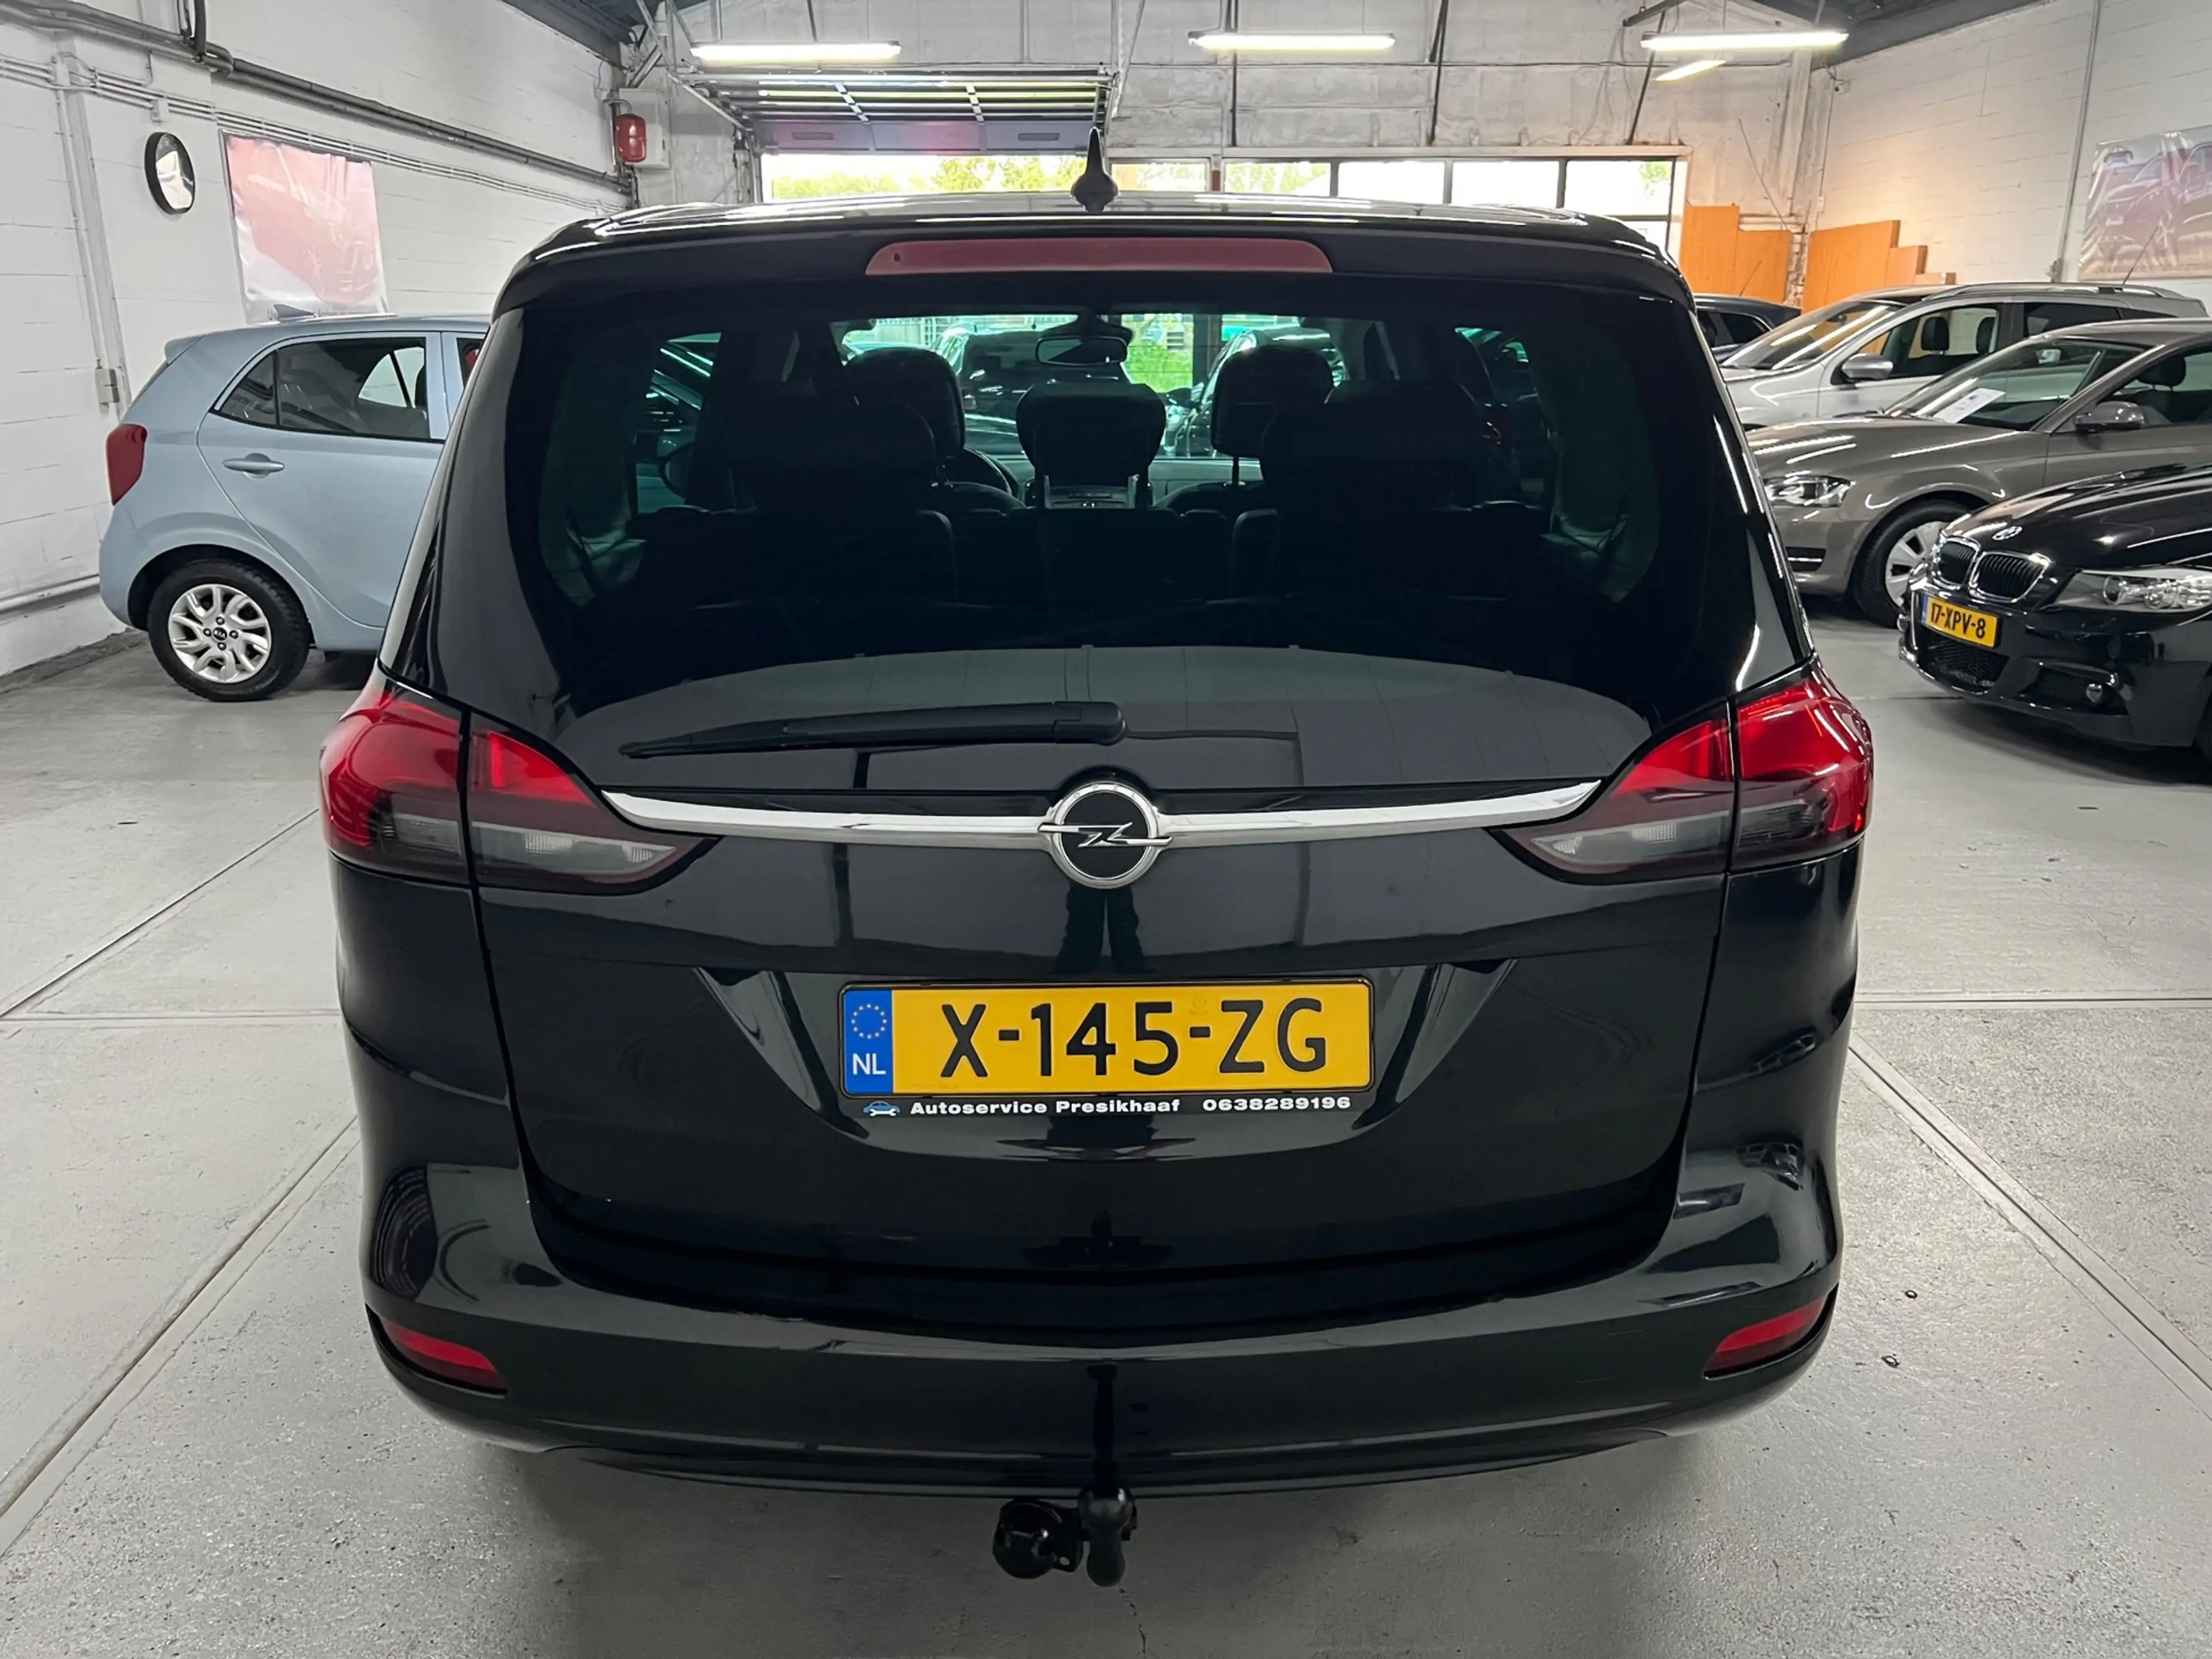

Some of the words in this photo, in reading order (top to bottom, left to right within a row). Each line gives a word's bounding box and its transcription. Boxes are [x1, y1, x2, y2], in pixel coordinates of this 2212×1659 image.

[1931, 603, 1986, 639] 17-XPV-8
[940, 997, 1327, 1078] X-145-ZG
[852, 1052, 887, 1075] NL
[910, 1100, 1048, 1115] Autoservice
[1055, 1098, 1180, 1113] Presikhaaf
[1202, 1096, 1351, 1111] 0638289196
